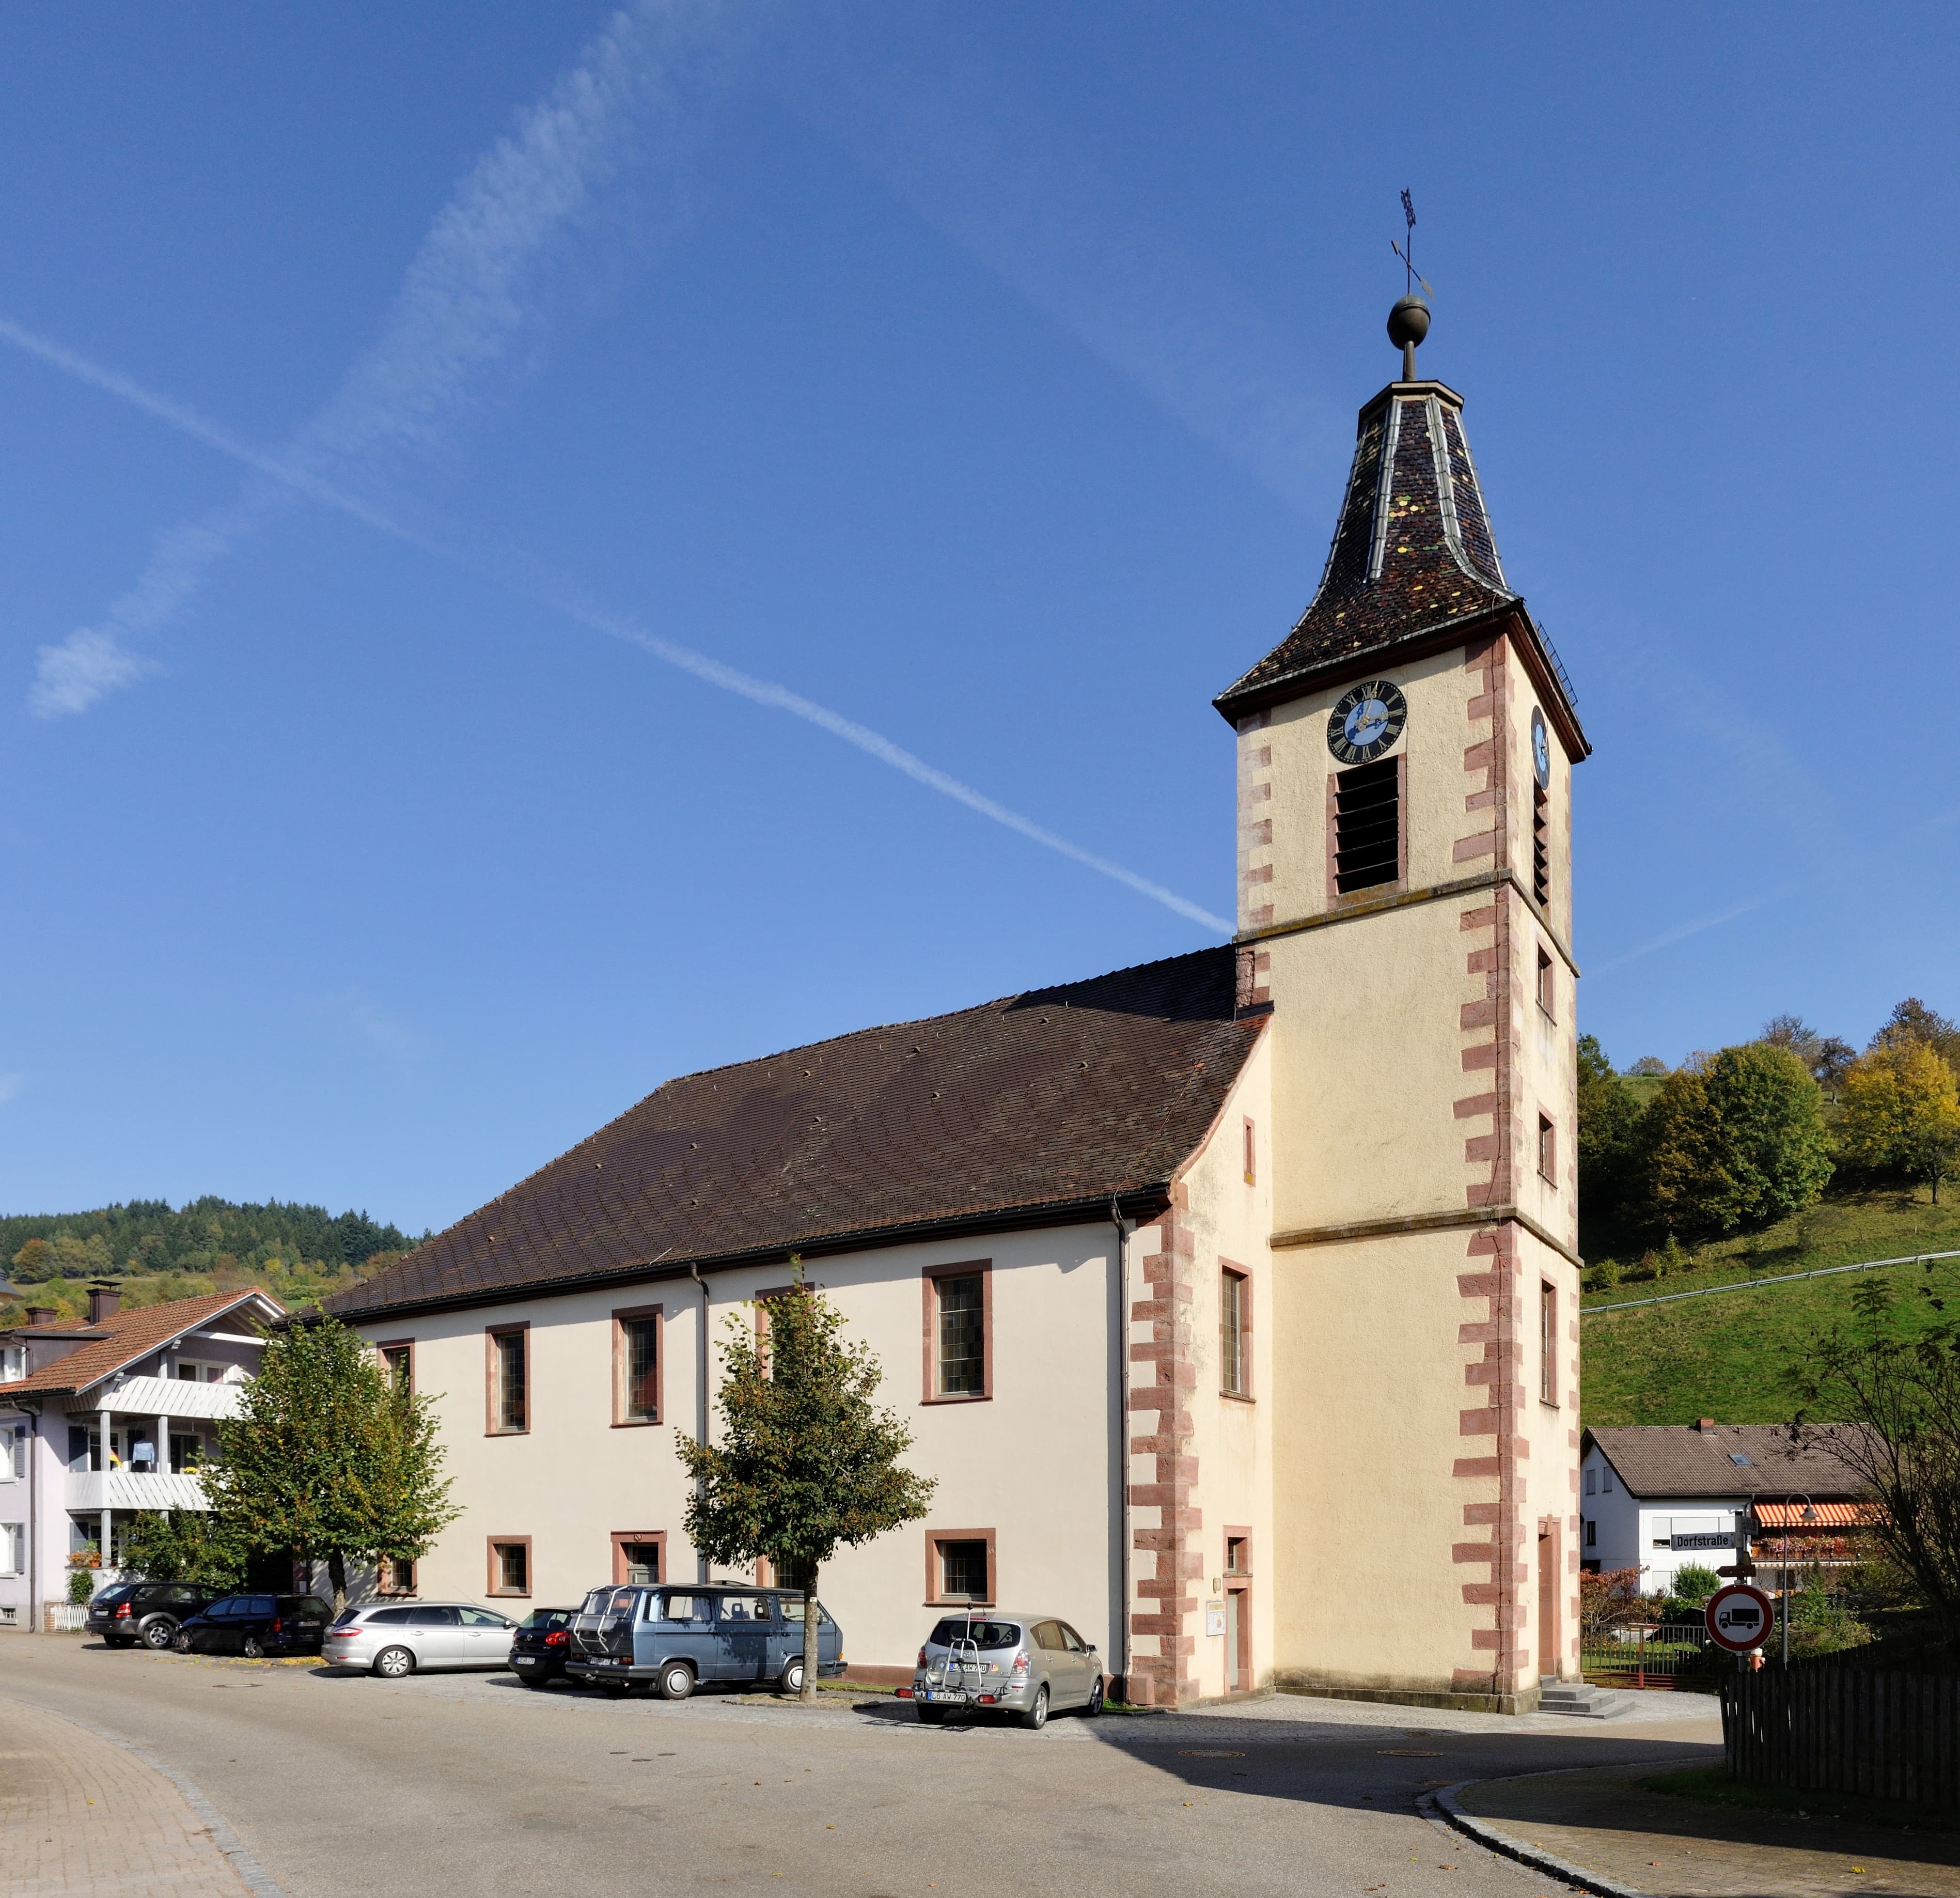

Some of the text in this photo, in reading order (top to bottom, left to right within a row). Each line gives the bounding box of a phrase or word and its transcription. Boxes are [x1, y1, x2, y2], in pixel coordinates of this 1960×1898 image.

[1346, 694, 1358, 708] XI
[1386, 693, 1399, 705] II
[1334, 711, 1347, 720] X
[1677, 1535, 1728, 1547] Dorfstraße
